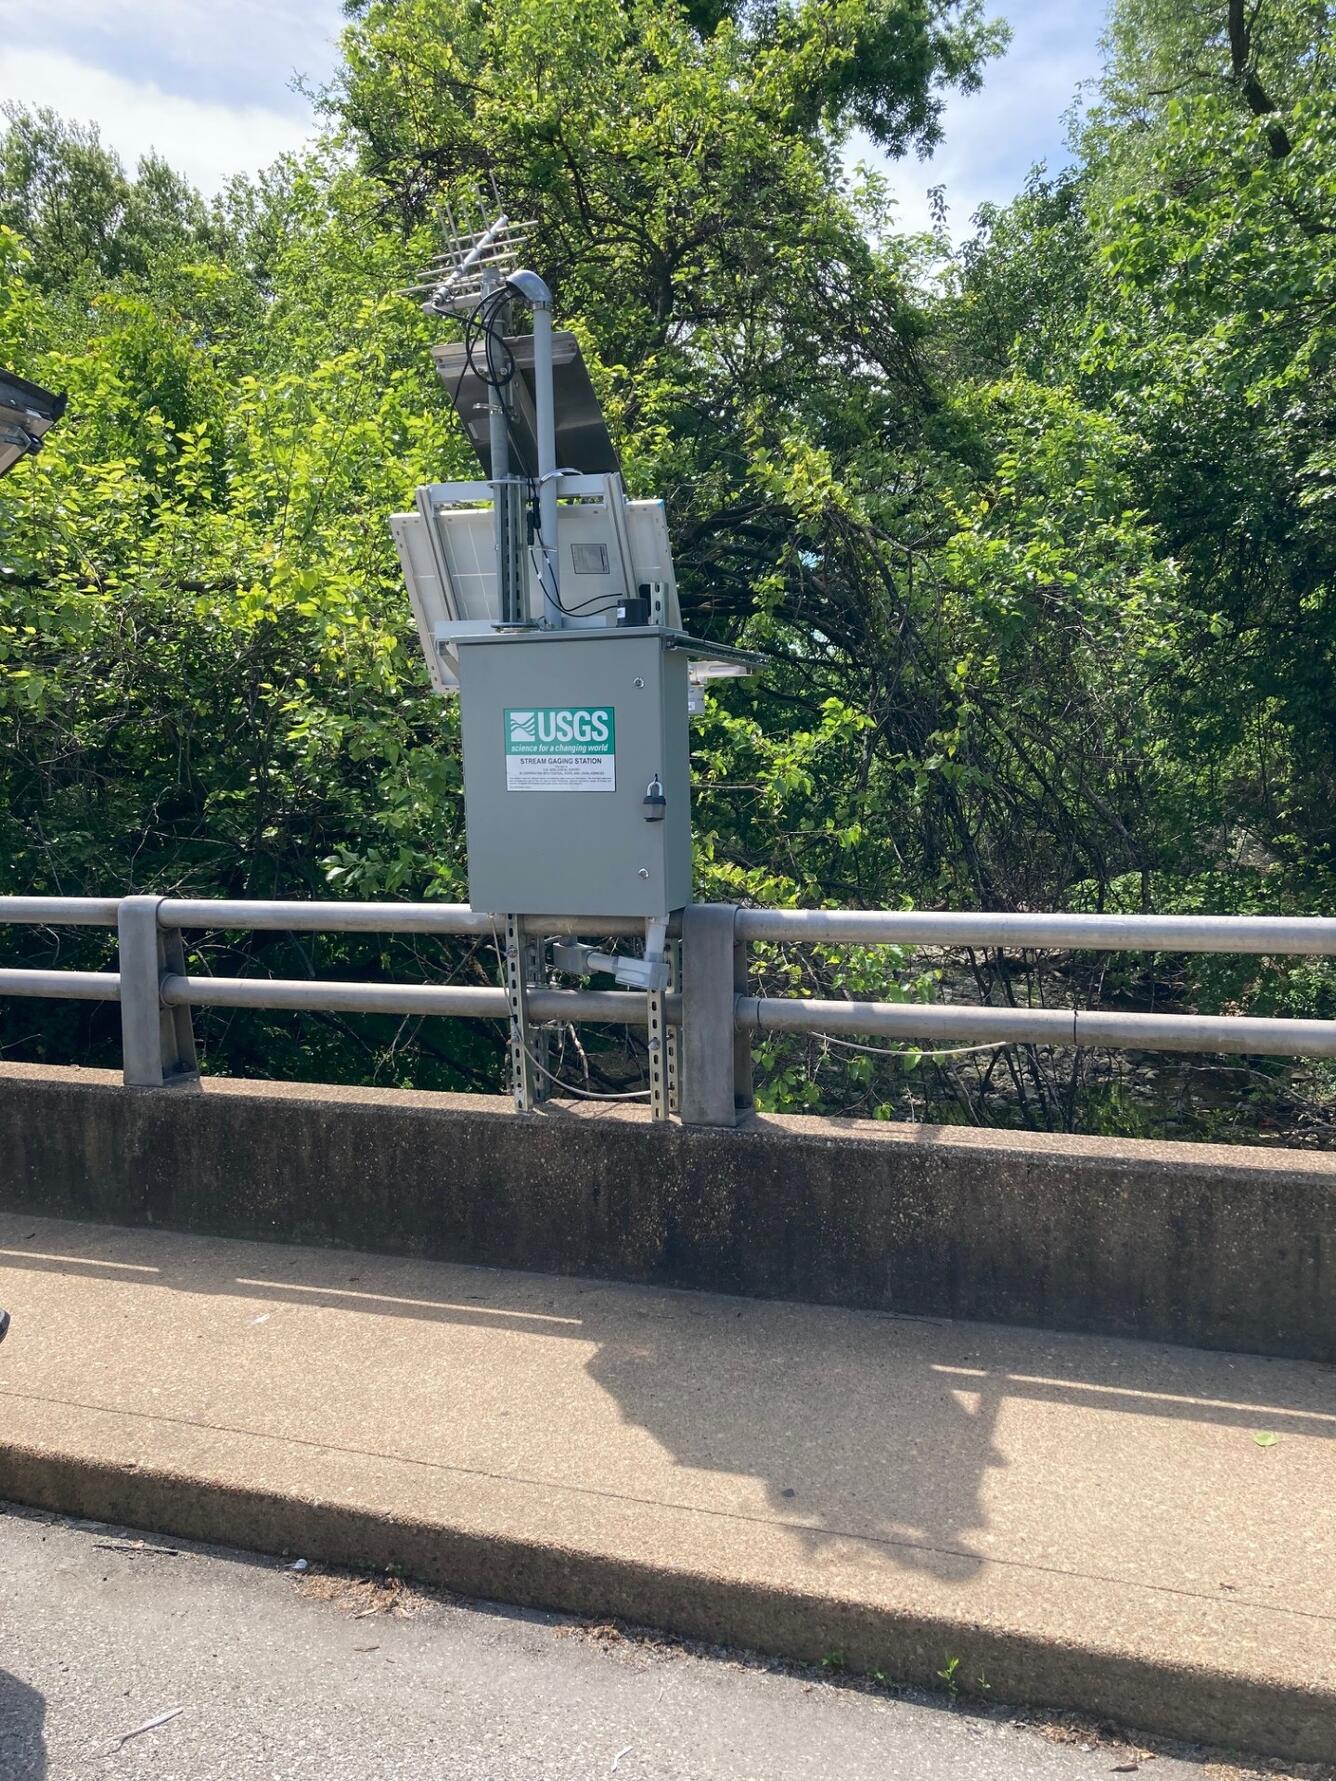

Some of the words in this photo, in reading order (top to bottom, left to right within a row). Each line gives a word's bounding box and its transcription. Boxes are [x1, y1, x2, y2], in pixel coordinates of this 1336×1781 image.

[538, 711, 608, 741] USGS
[539, 744, 549, 752] for
[555, 744, 586, 753] changing
